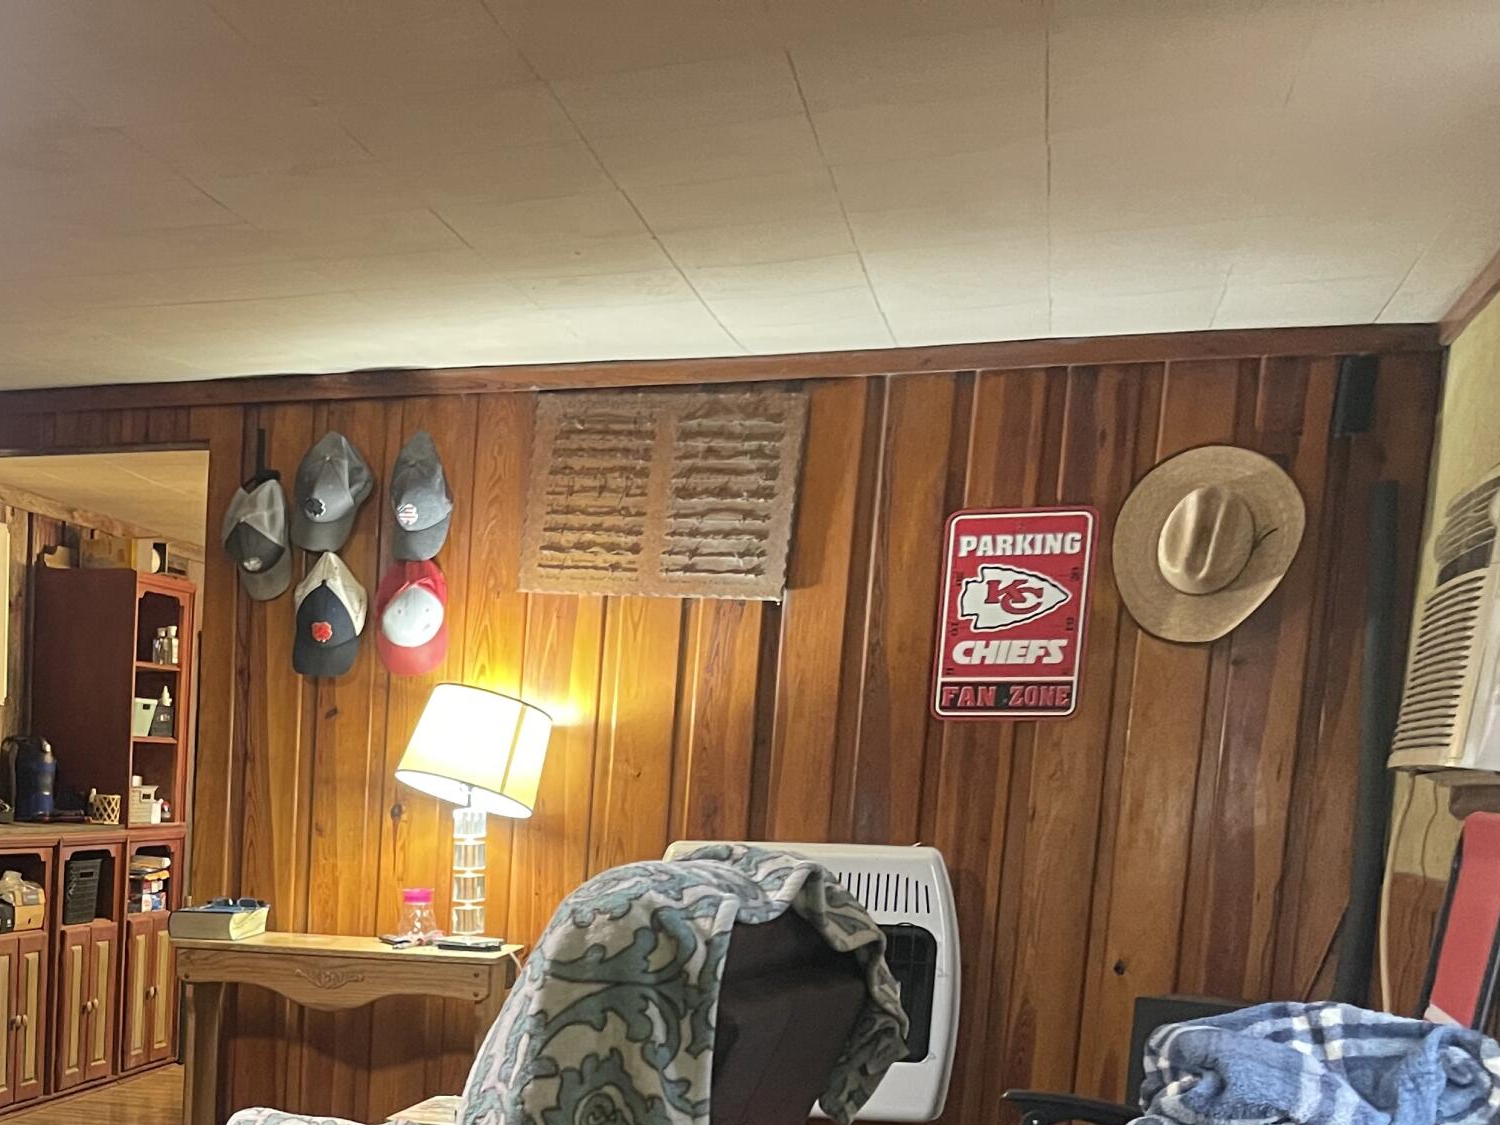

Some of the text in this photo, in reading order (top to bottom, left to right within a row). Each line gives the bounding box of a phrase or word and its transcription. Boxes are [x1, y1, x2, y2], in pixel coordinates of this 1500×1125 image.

[958, 532, 1082, 558] PARKING
[984, 579, 1044, 615] KC
[952, 639, 1068, 665] CHIEFS
[941, 686, 1071, 707] FAN ZONE
